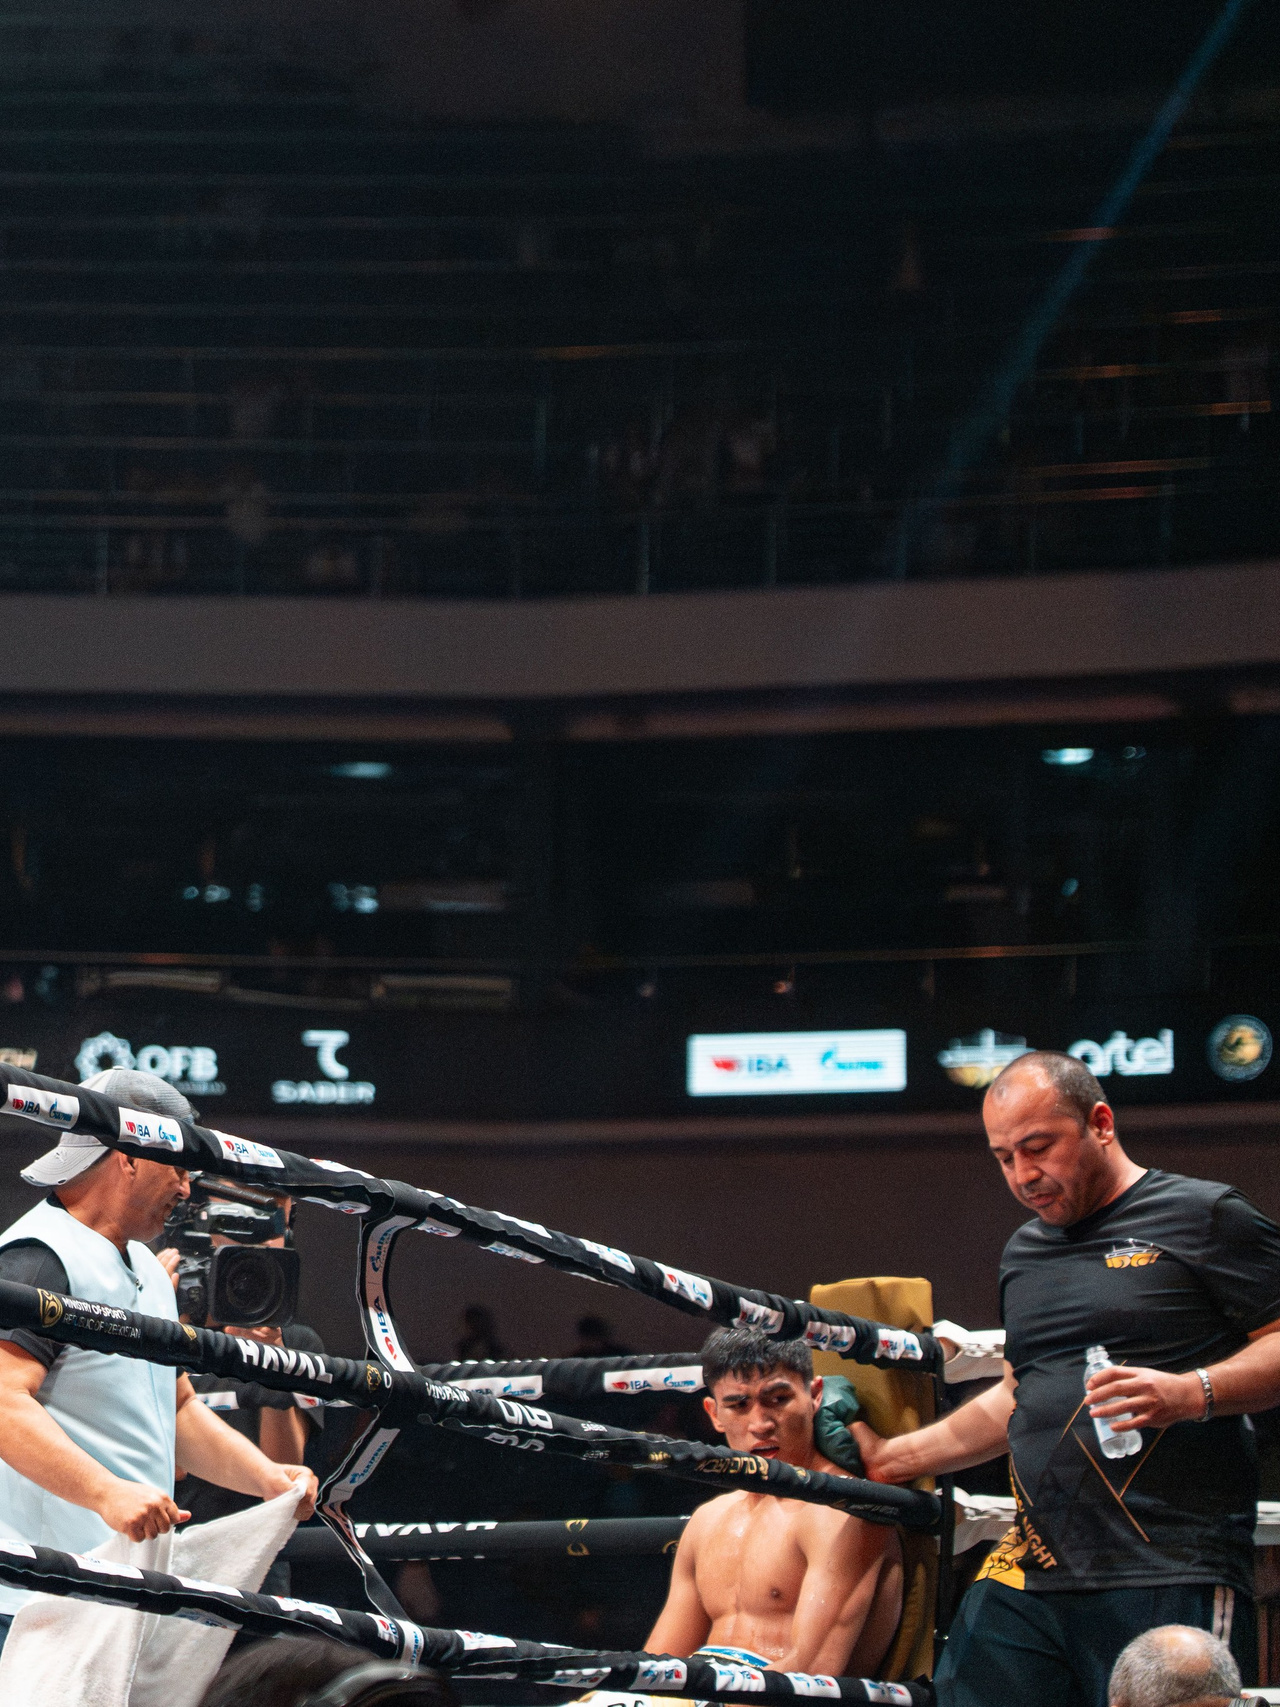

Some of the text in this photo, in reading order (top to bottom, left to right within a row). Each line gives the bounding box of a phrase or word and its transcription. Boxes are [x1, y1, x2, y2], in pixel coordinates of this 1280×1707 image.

[746, 1055, 791, 1075] IBA
[1068, 1029, 1174, 1076] artel
[23, 1100, 40, 1115] IBA
[373, 1295, 389, 1334] IBA
[235, 1338, 334, 1384] HAVAL
[630, 1380, 653, 1390] IBA
